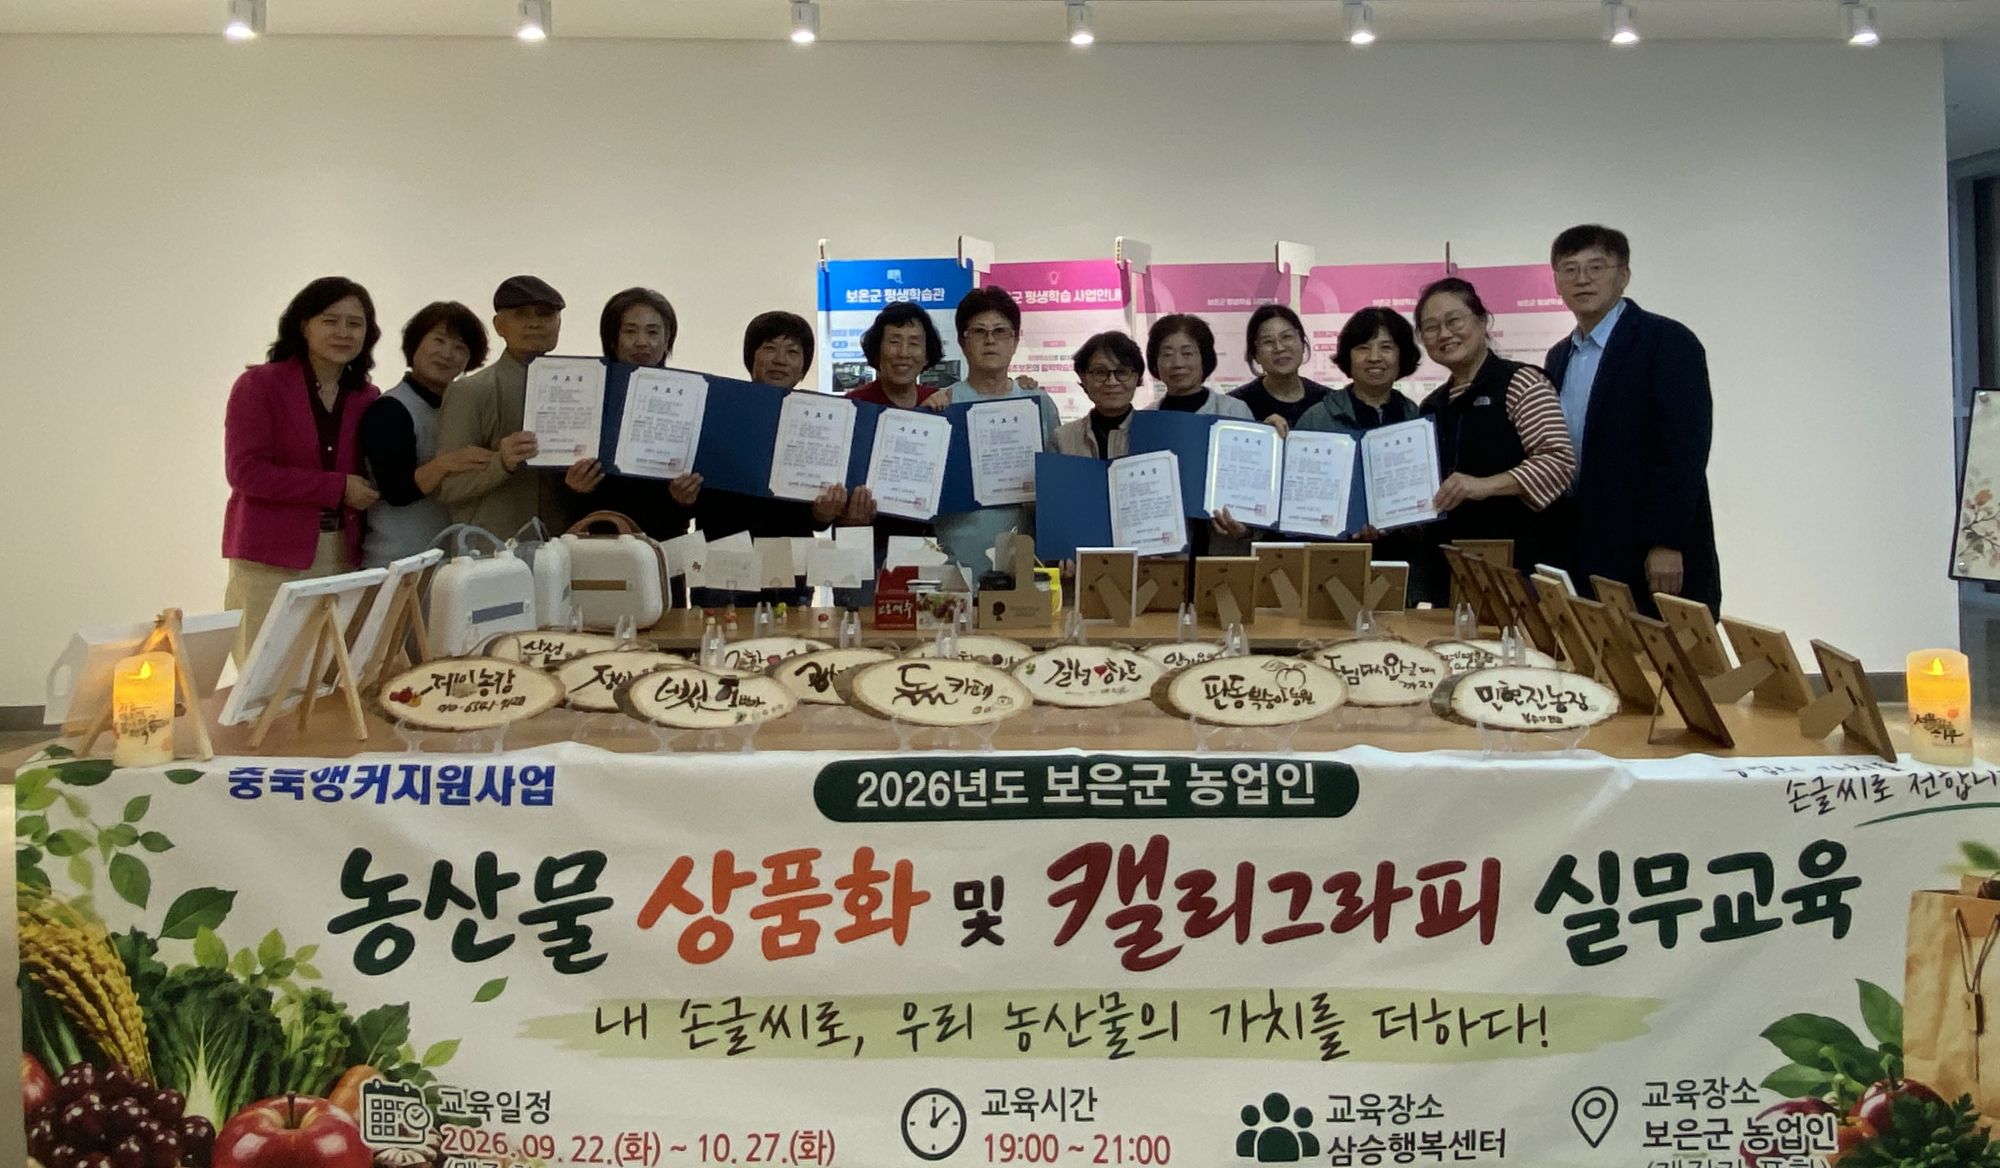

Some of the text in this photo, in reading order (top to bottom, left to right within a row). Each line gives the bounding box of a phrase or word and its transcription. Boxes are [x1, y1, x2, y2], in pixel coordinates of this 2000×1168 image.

[846, 287, 946, 303] 보은군 평생학습관
[856, 763, 1316, 808] 2026년도 보은군 농업인
[1785, 769, 2000, 816] 손글씨로 전합니
[328, 834, 1862, 976] 농산물 상품화 및 캘리그라피 실무교육
[595, 988, 1549, 1062] 내 손글씨로, 우리 농산물의 가치를 더하다!
[439, 1090, 552, 1125] 교육일정
[981, 1086, 1098, 1123] 교육시간
[1326, 1093, 1445, 1127] 교육장소
[1641, 1076, 1761, 1111] 교육장소
[984, 1133, 1059, 1163] 19:00
[1092, 1134, 1171, 1165] 21:00
[1327, 1127, 1506, 1167] 삼승행복센터
[1642, 1115, 1837, 1152] 보은군 농업인
